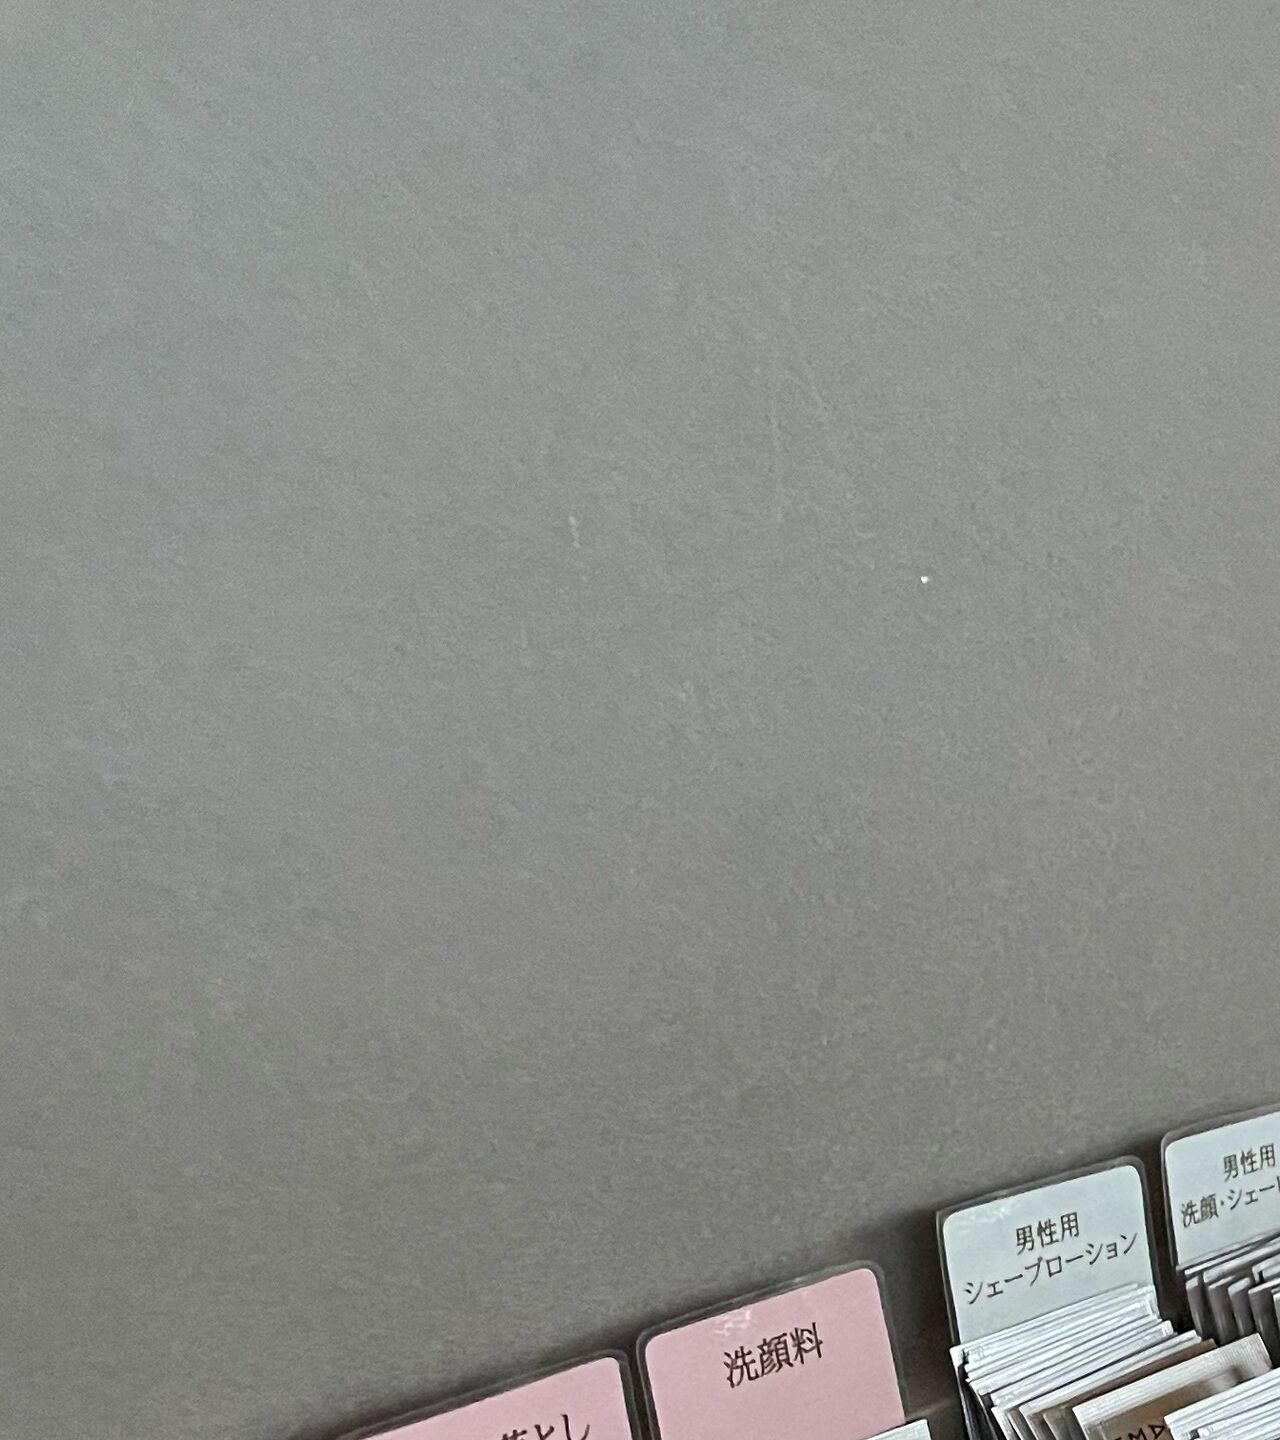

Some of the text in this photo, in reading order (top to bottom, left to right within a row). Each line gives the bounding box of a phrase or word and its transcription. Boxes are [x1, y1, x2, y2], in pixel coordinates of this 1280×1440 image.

[1222, 1142, 1278, 1183] 男性用
[1015, 1210, 1081, 1256] 男性用
[722, 1321, 825, 1389] 洗顔料
